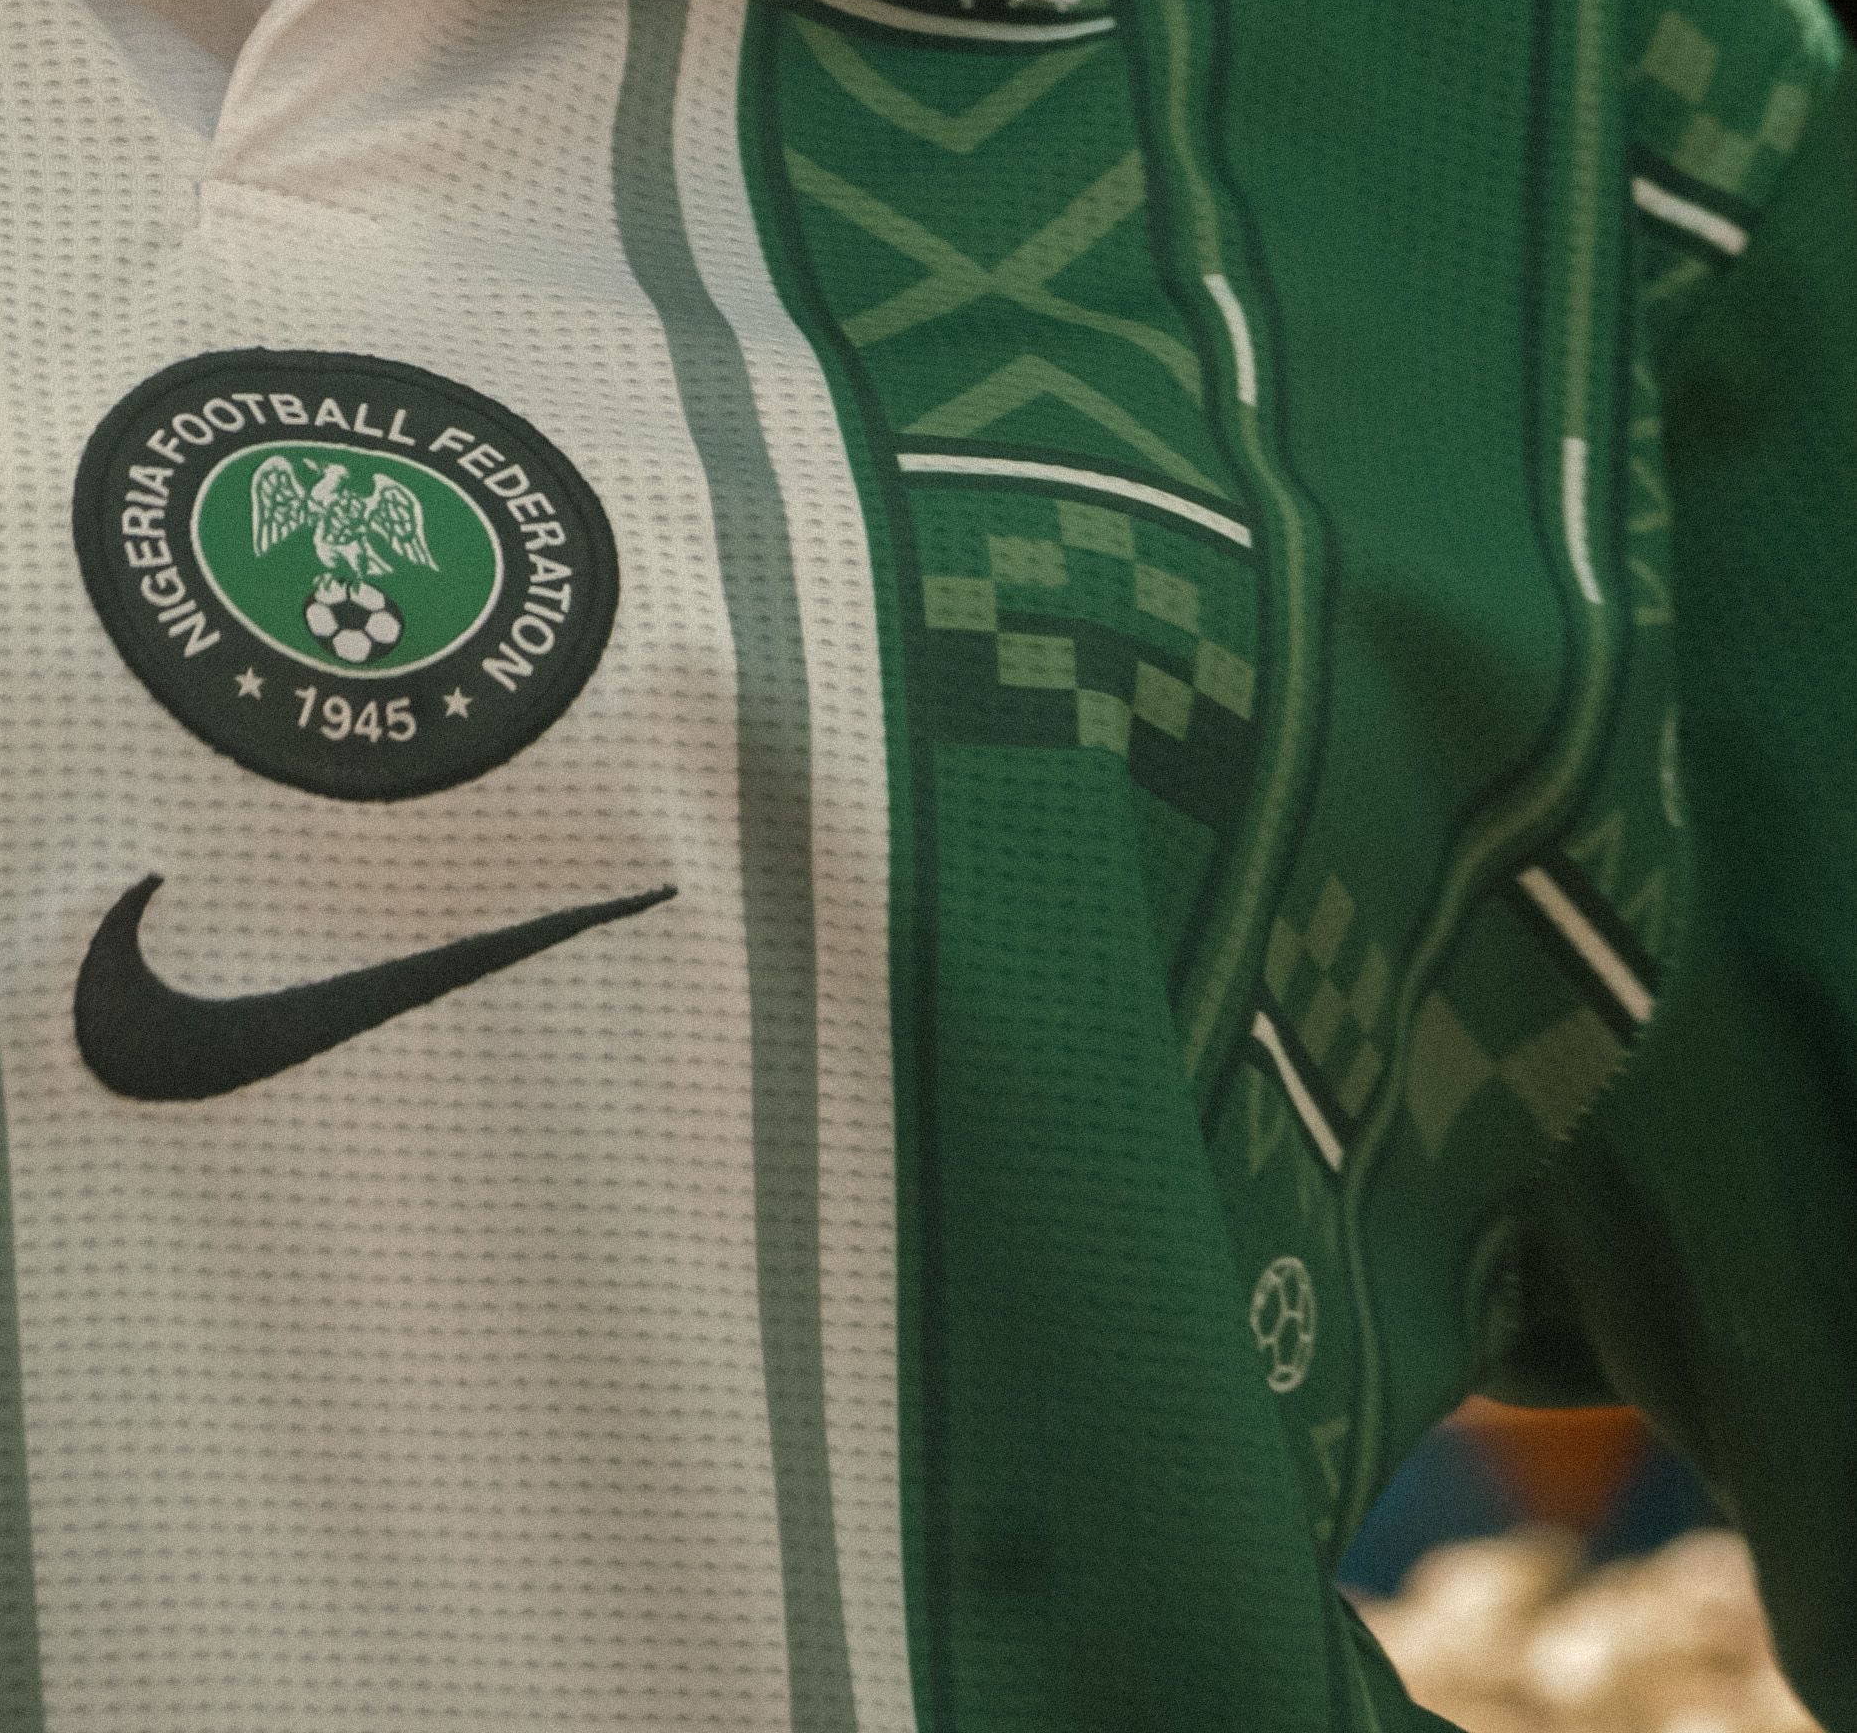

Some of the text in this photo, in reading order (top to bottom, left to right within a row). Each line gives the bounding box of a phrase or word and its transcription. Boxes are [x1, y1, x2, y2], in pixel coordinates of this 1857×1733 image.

[121, 392, 573, 691] NIGERIA FOOTBALL FEDERATION
[294, 685, 417, 743] 1945
